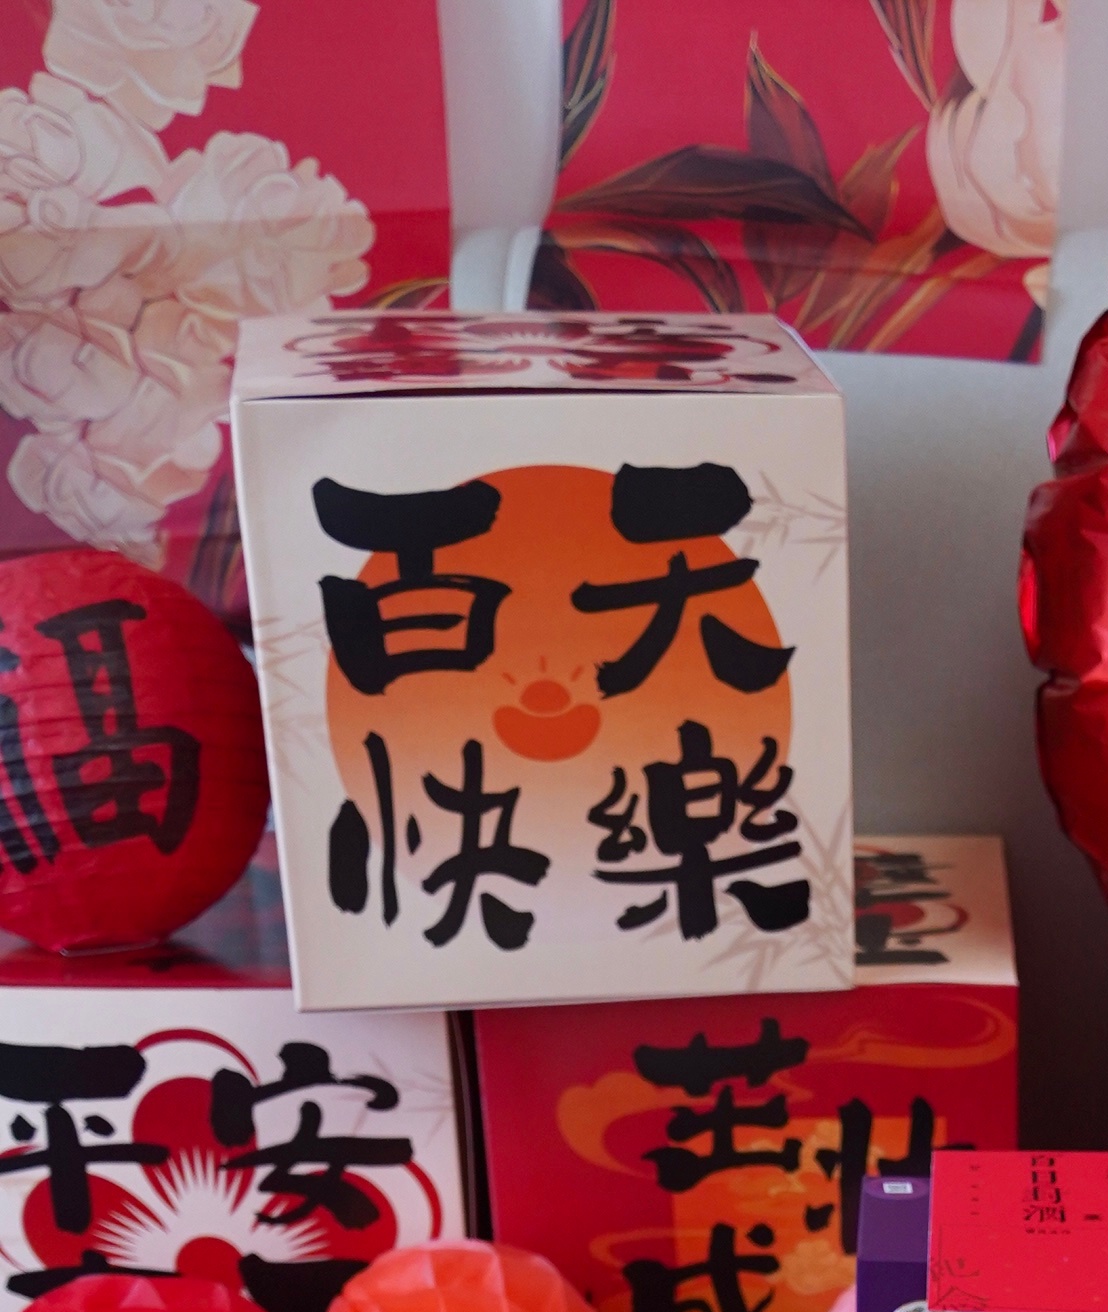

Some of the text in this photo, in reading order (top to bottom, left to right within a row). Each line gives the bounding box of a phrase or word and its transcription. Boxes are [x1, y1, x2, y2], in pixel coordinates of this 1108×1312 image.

[311, 462, 796, 696] 百天
[327, 720, 810, 950] 快樂
[0, 1041, 412, 1234] 平安
